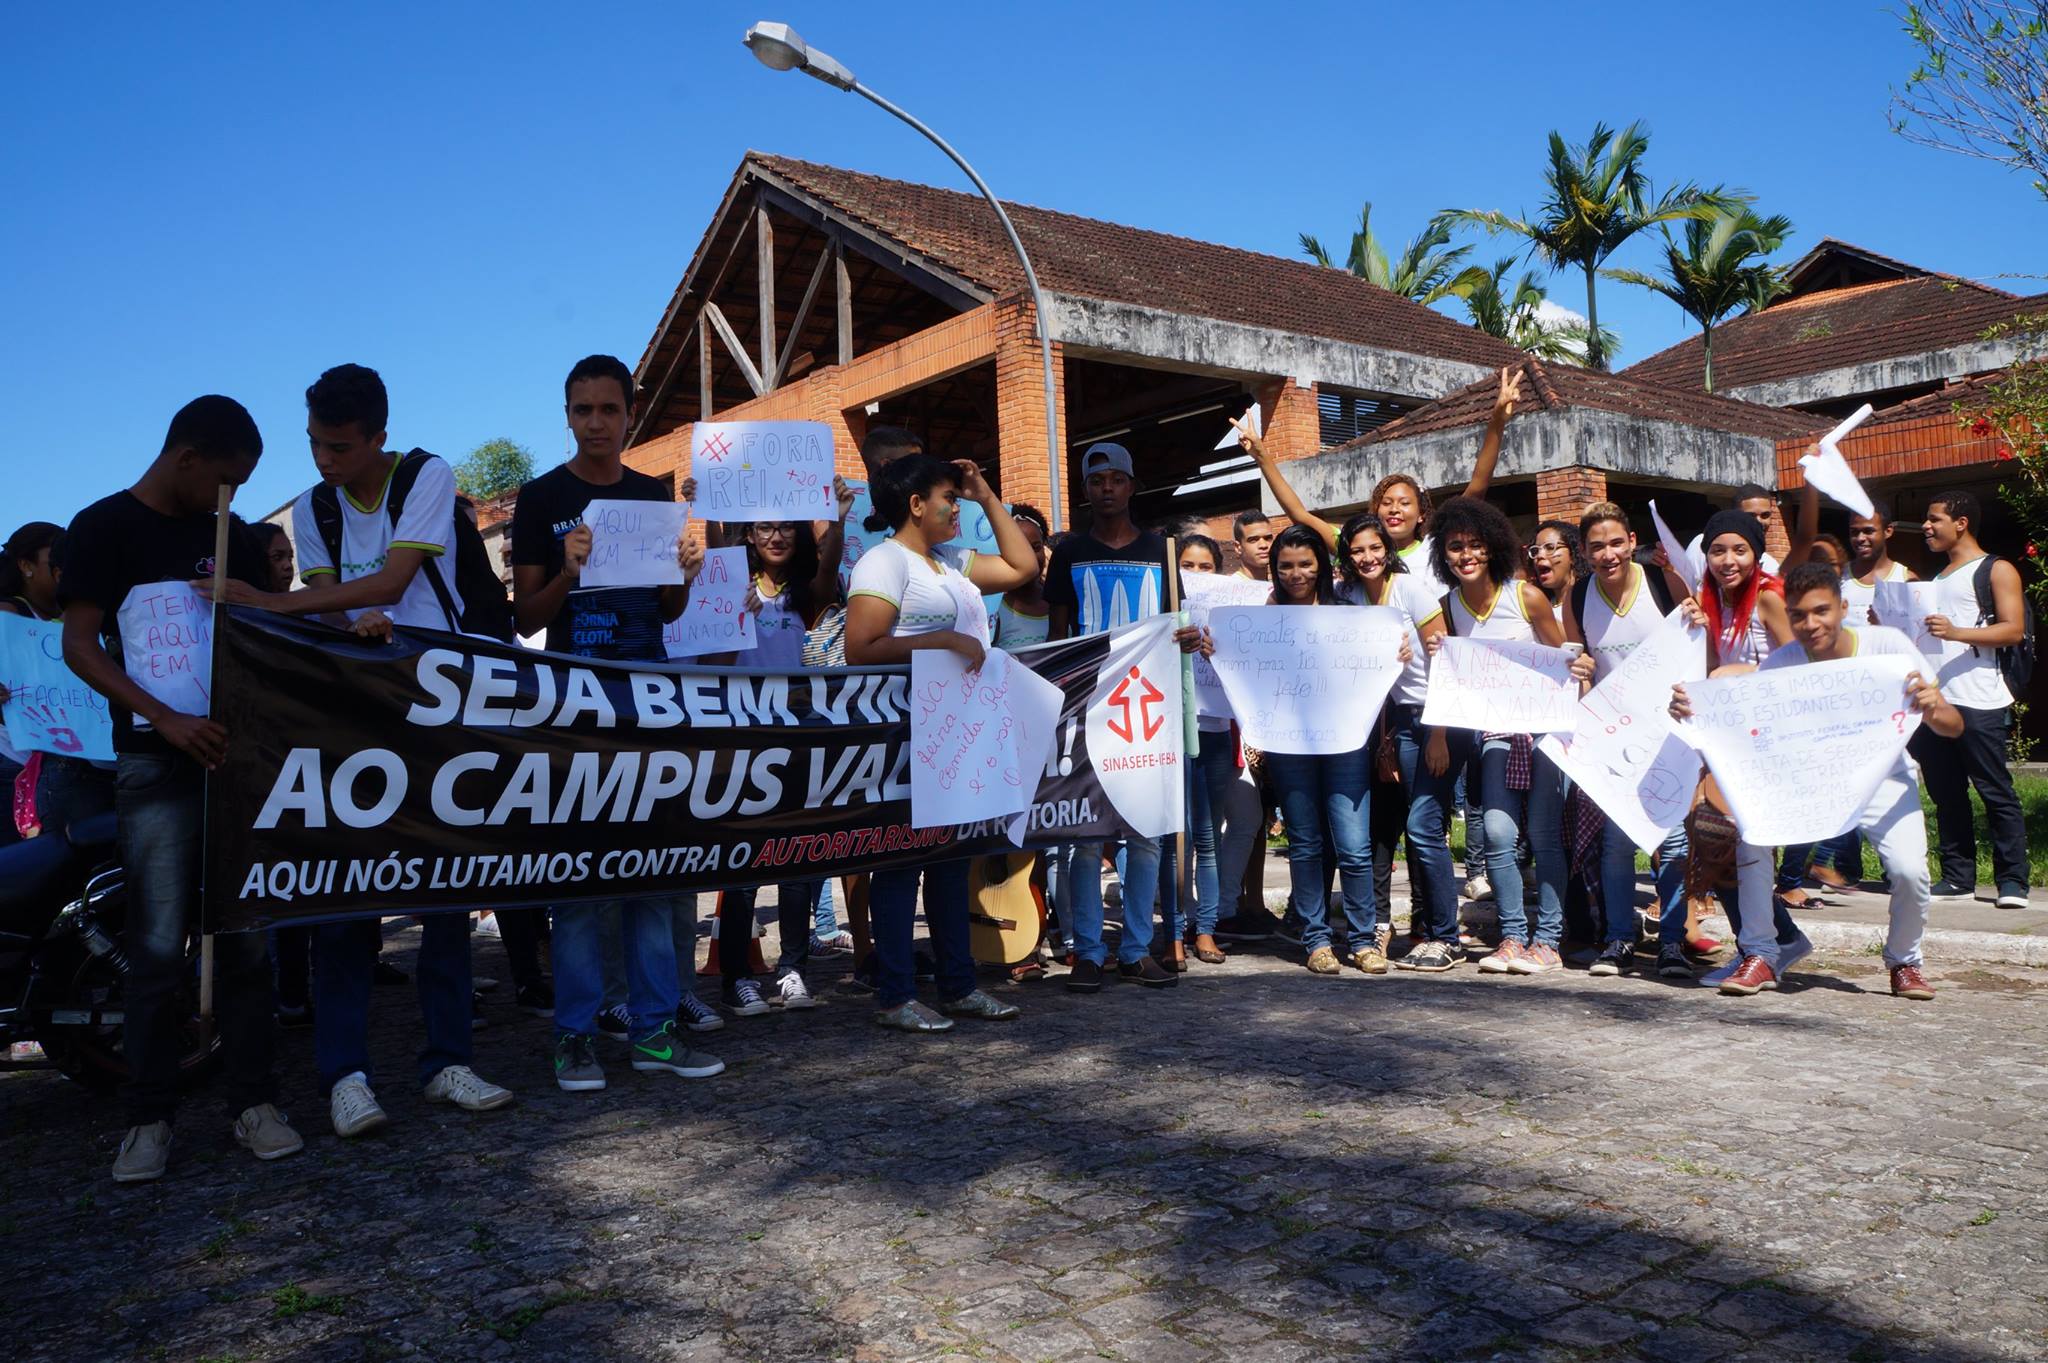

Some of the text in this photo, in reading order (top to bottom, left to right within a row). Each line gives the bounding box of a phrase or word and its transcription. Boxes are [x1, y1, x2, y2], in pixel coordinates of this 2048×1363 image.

[593, 507, 643, 535] AQUI
[142, 593, 201, 619] TEM
[150, 653, 192, 679] EM
[1470, 641, 1513, 673] NÃO
[1518, 648, 1558, 669] SOU
[406, 648, 912, 729] SEJA BEM VIN
[1702, 668, 1875, 707] VOCÊ SE IMPORTA
[1695, 712, 1720, 730] OM
[1723, 709, 1746, 727] OS
[1753, 692, 1852, 724] ESTUDANTES
[1860, 688, 1887, 706] DO
[1102, 750, 1177, 773] SINASEFE-IFBA
[253, 747, 409, 830] AO
[430, 747, 791, 827] CAMPUS
[239, 860, 338, 902] AQUI
[343, 850, 424, 894] NÓS
[429, 851, 593, 890] LUTAMOS
[599, 844, 720, 881] CONTRA
[727, 842, 751, 870] O
[752, 822, 955, 869] AUTORITARISMO
[956, 819, 989, 841] DA
